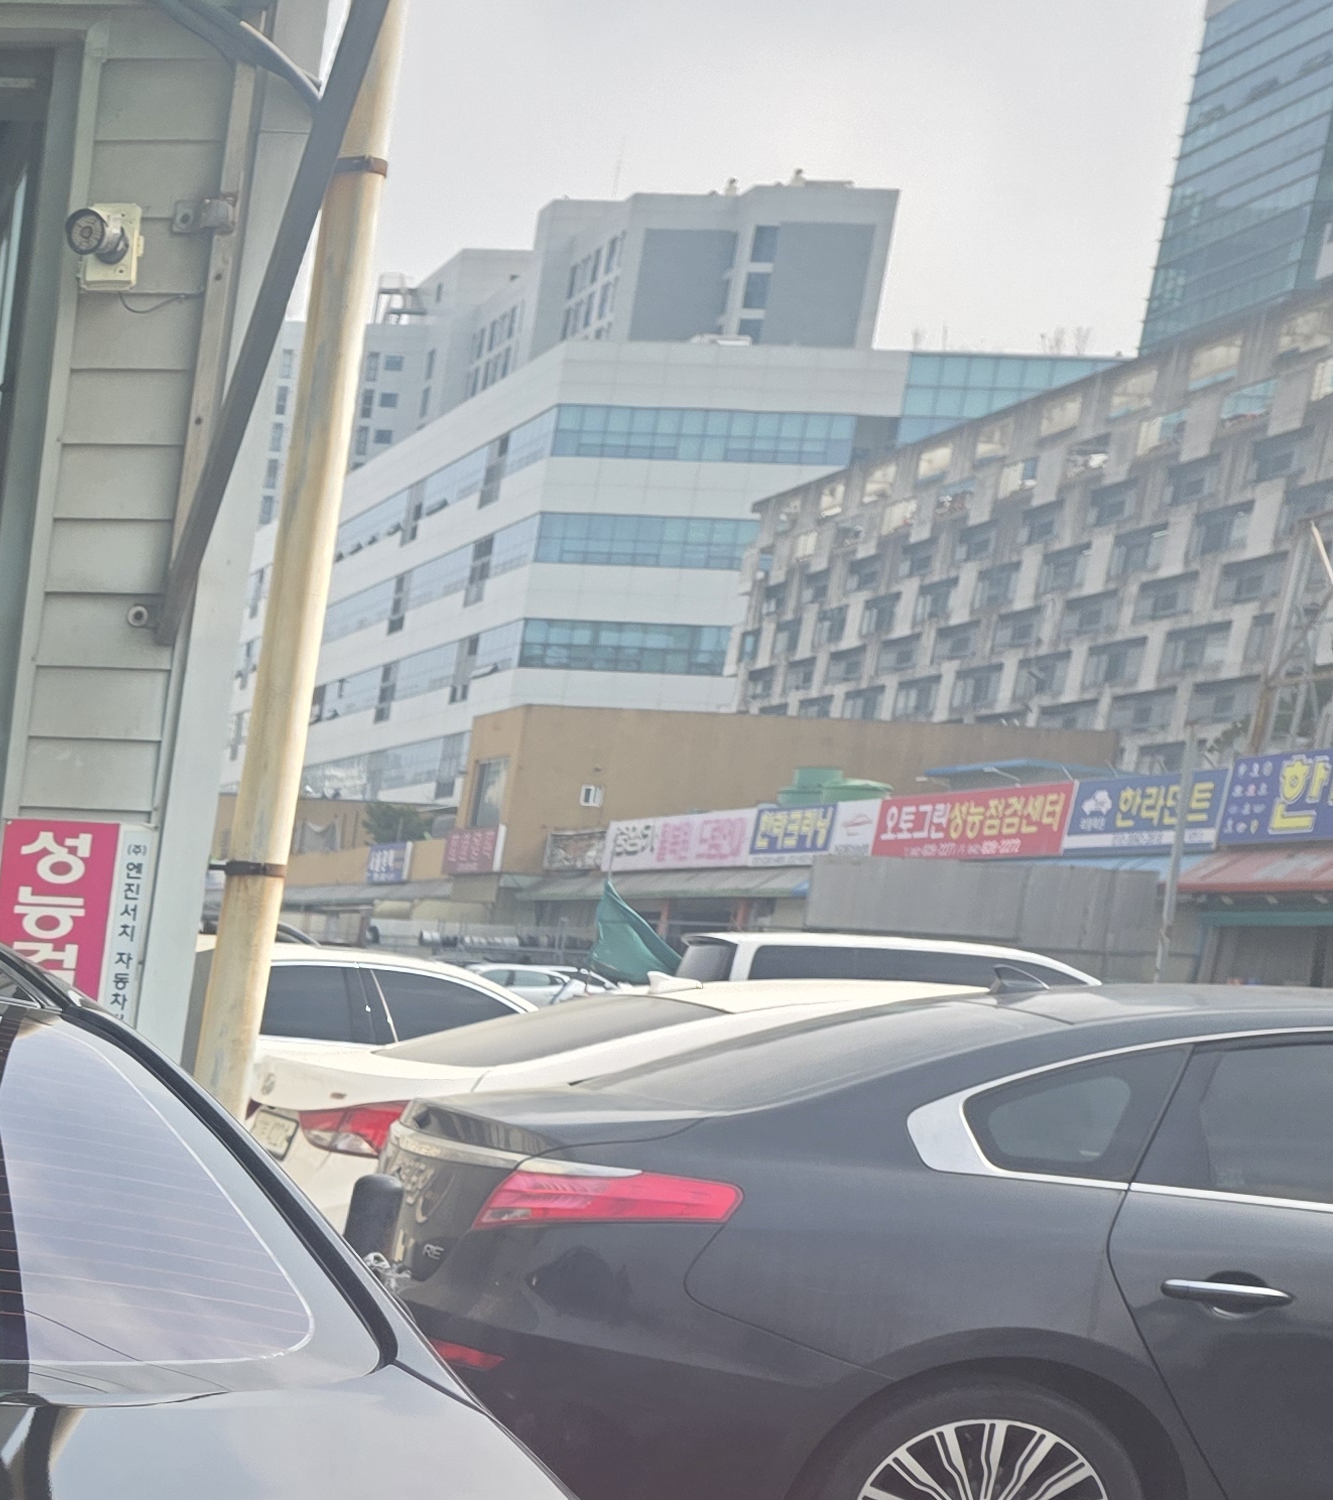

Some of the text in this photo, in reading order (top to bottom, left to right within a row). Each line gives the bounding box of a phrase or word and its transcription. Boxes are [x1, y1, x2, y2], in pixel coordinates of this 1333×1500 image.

[880, 792, 1067, 841] 오토그린 성능점검센터
[1267, 754, 1333, 834] 한
